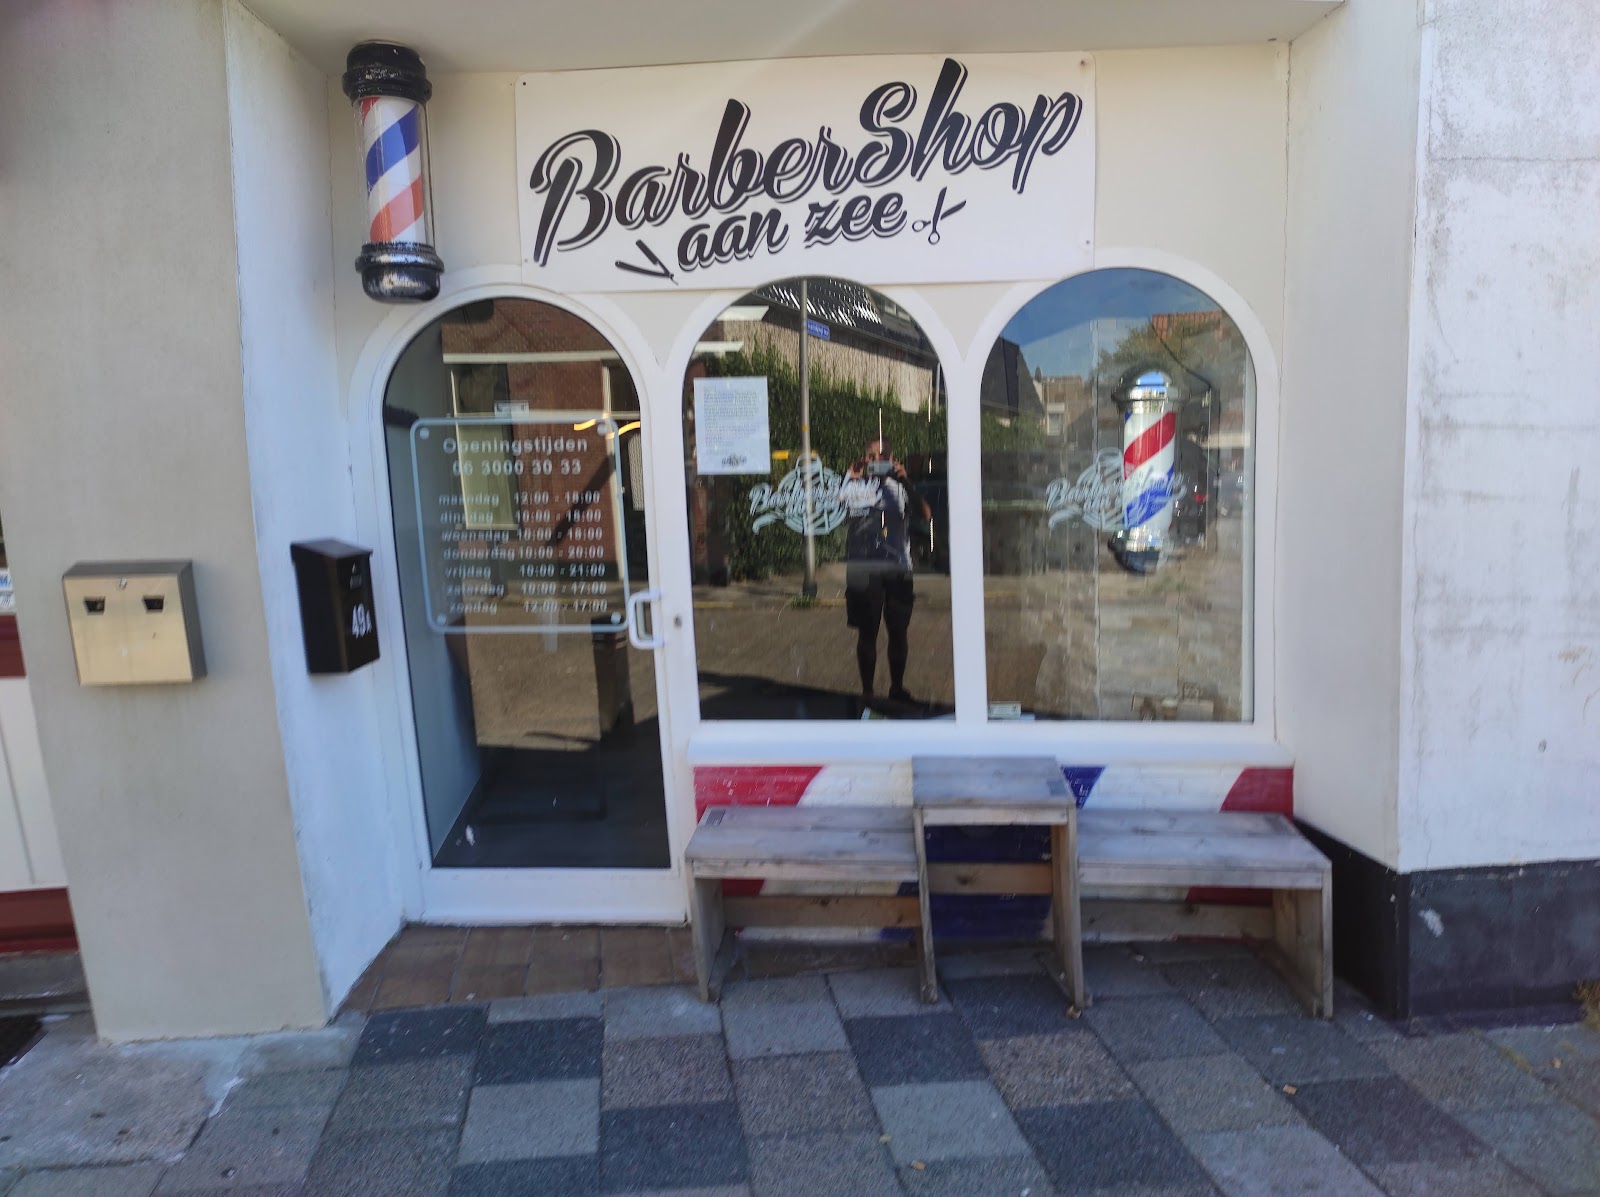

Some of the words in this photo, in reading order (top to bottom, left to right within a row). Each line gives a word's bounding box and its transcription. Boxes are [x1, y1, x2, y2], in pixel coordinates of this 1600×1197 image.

[530, 58, 1083, 268] BarberShop
[678, 203, 789, 271] aan
[803, 191, 907, 249] zee
[443, 436, 588, 456] Openingstijden
[453, 460, 473, 476] 06
[481, 460, 524, 476] 3000
[532, 460, 553, 475] 30
[561, 459, 582, 474] 33
